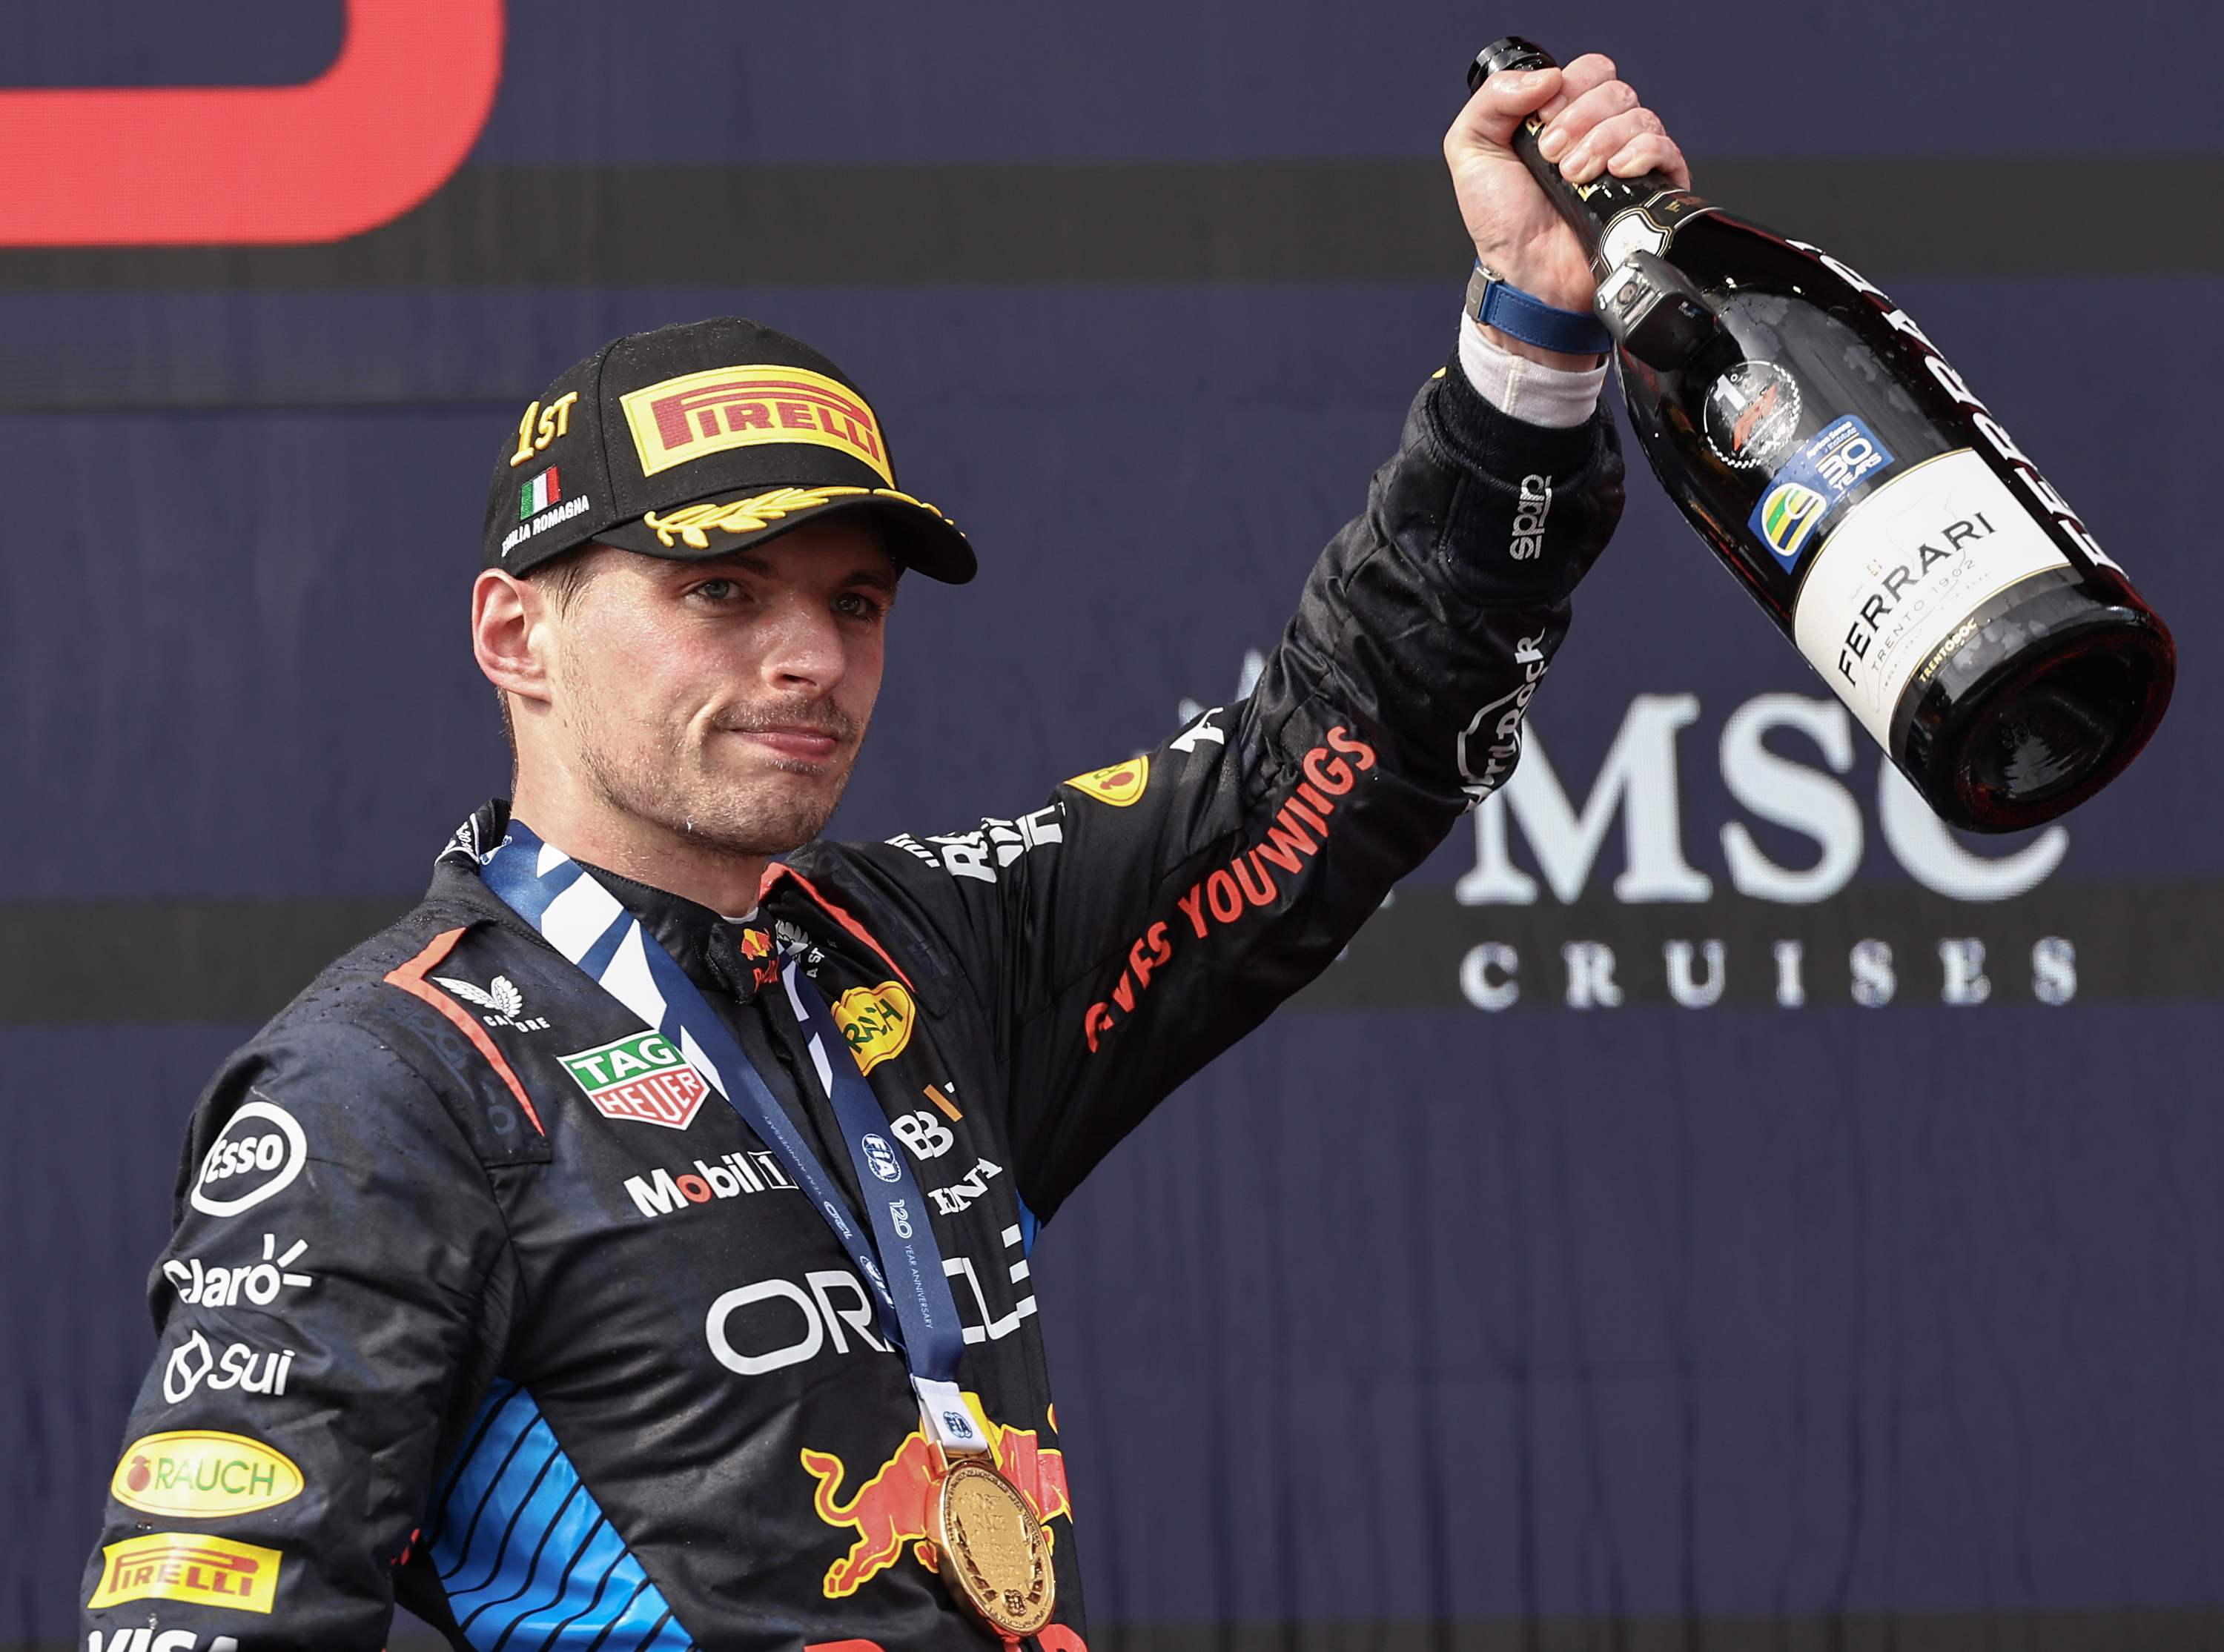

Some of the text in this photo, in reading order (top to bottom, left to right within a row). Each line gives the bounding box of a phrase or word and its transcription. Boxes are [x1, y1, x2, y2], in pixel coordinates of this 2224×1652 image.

[510, 391, 579, 467] 1ST
[650, 379, 880, 461] PIRELLI
[1818, 437, 1873, 485] 30
[1833, 451, 1882, 491] YEARS
[532, 494, 590, 536] ROMAGNA
[1838, 511, 1997, 689] FERRARI
[1871, 600, 1925, 672] TRENTO
[1931, 560, 1976, 594] 1902
[1919, 617, 1978, 683] TRENTODOC
[1455, 692, 2069, 904] MSC
[1177, 849, 1277, 939] YOU
[1459, 937, 2077, 1010] CRUISES
[571, 1038, 678, 1084] TAG
[598, 1071, 700, 1122] HEUER
[623, 1152, 790, 1218] Mobil 1
[889, 1198, 913, 1239] 120
[162, 1258, 282, 1308] Claro
[904, 1244, 918, 1267] YEAR
[910, 1267, 934, 1330] ANNIVERSARY
[155, 1457, 275, 1496] RAUCH
[108, 1546, 259, 1597] PIRELLI
